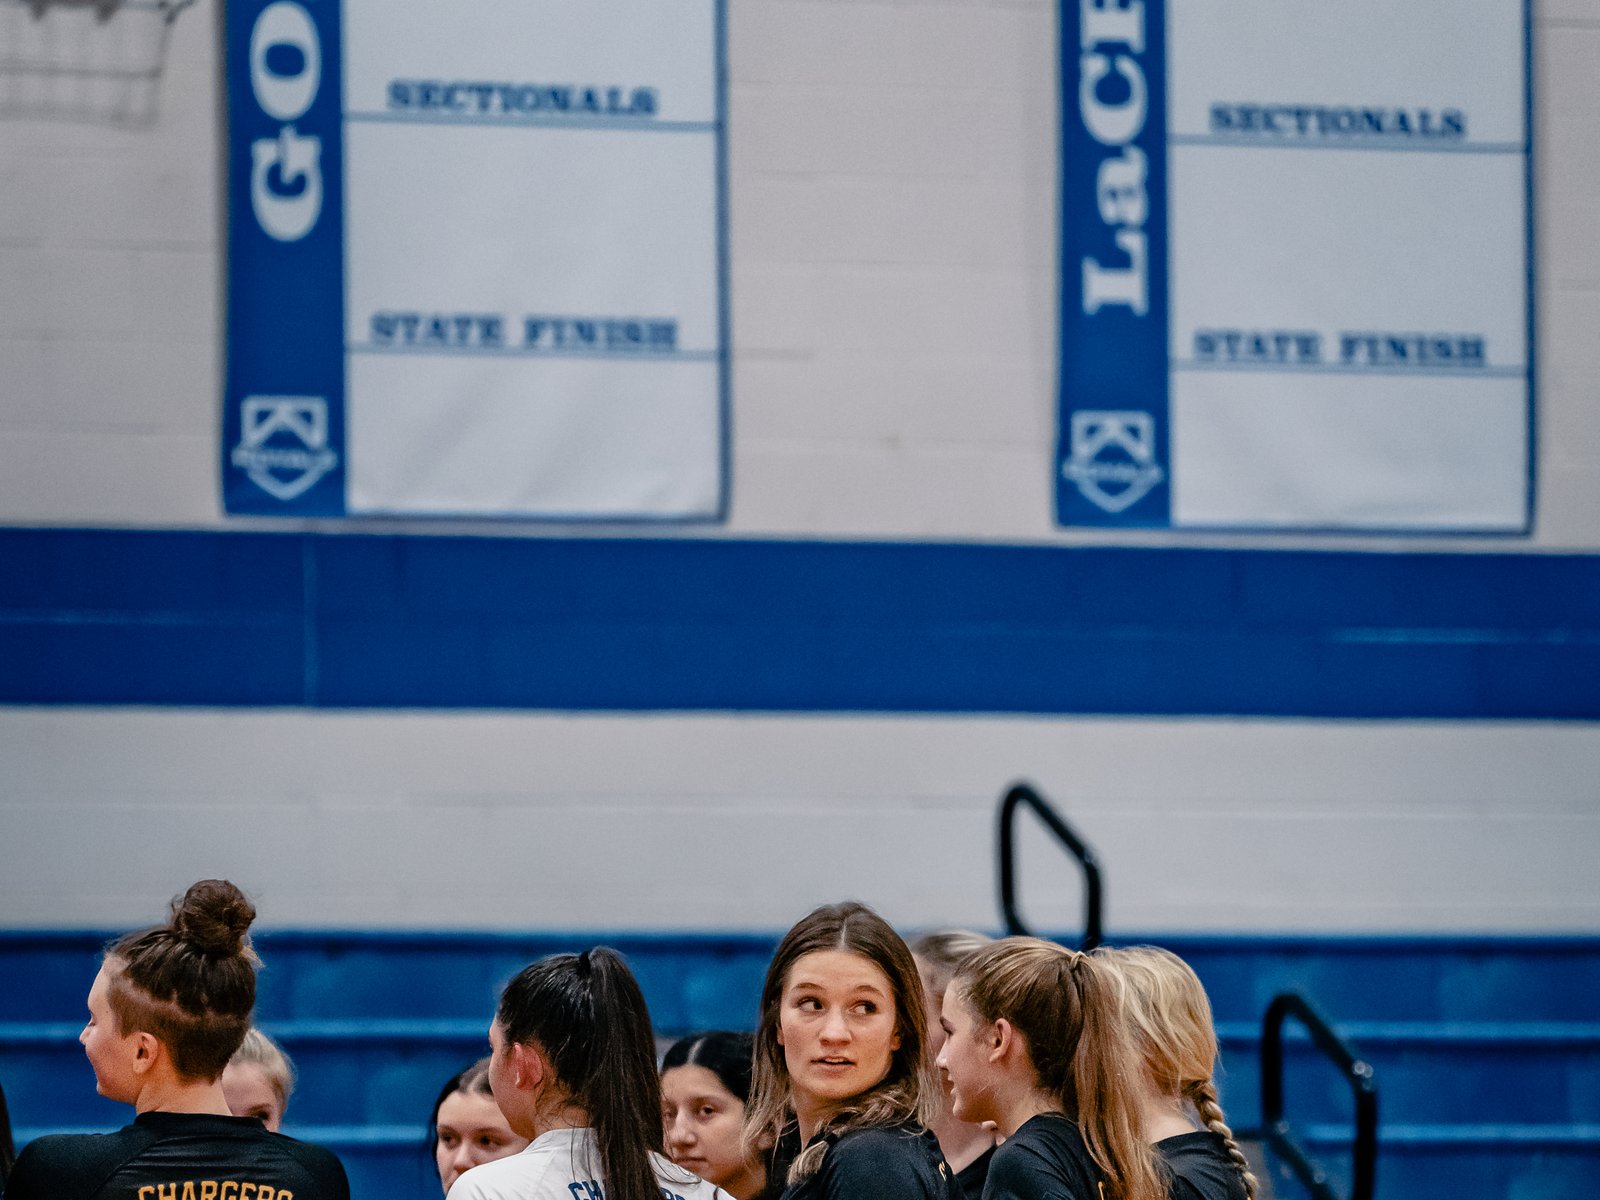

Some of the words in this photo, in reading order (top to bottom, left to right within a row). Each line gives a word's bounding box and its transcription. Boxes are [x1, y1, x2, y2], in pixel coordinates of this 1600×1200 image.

[386, 78, 660, 116] SECTIONALS
[1208, 101, 1468, 140] SECTIONALS
[370, 311, 504, 348] STATE
[523, 316, 679, 352] FINISH
[1194, 329, 1321, 364] STATE
[1339, 332, 1487, 368] FINISH
